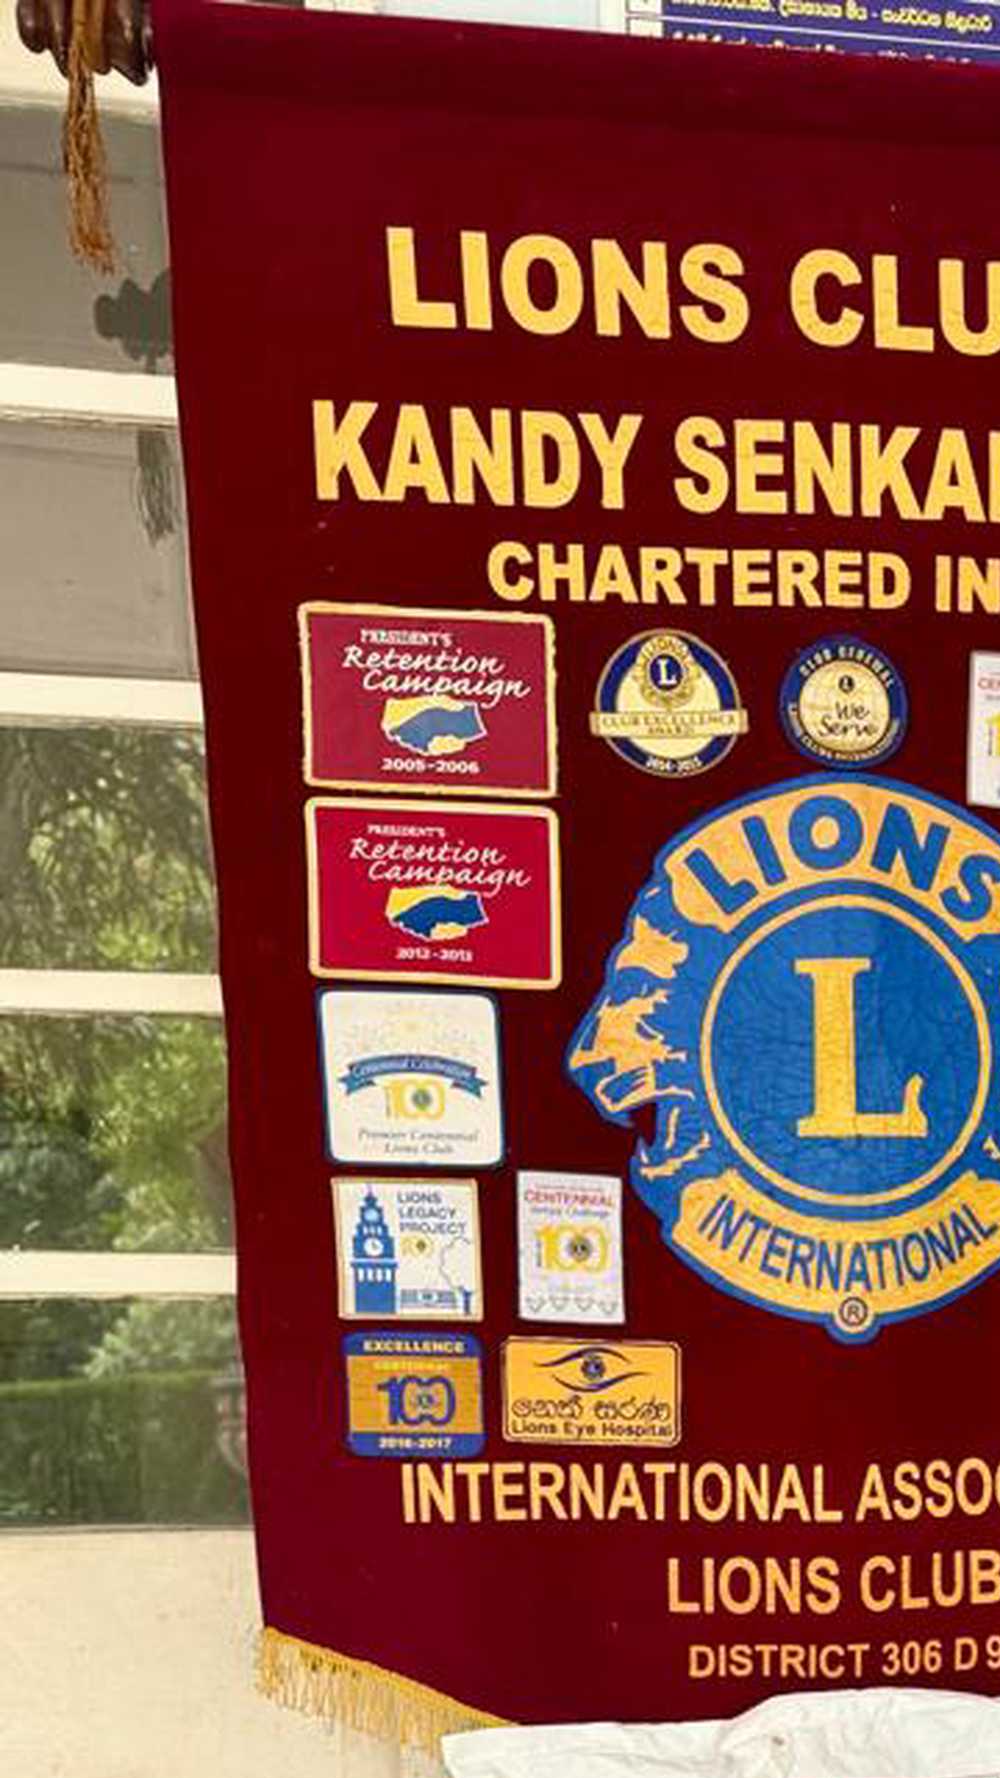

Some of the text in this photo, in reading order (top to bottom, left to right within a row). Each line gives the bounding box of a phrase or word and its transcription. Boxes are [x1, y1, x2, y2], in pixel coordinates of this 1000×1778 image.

[387, 226, 750, 342] LIONS
[311, 399, 643, 509] KANDY
[486, 541, 911, 609] CHARTERED
[342, 645, 505, 675] Retention
[362, 669, 531, 709] Campaign
[818, 713, 880, 737] Serve
[835, 701, 871, 720] We
[381, 758, 479, 773] 2005-2006
[349, 836, 507, 866] Retention
[367, 860, 532, 898] Campaign
[794, 957, 929, 1139] L
[397, 1191, 441, 1204] LIONS
[399, 1206, 457, 1220] LEGACY
[525, 1188, 614, 1206] CENTENNIAL
[400, 1222, 467, 1235] PROJECT
[698, 1193, 1000, 1294] INTERNATIONAL
[363, 1340, 465, 1354] EXCELLENCE
[377, 1374, 457, 1427] 100
[512, 1419, 674, 1439] Lions Eye Hospital
[401, 1462, 844, 1525] INTERNATIONAL
[667, 1555, 842, 1616] LIONS
[688, 1643, 870, 1678] DISTRICT
[882, 1637, 943, 1676] 306
[954, 1637, 978, 1670] D
